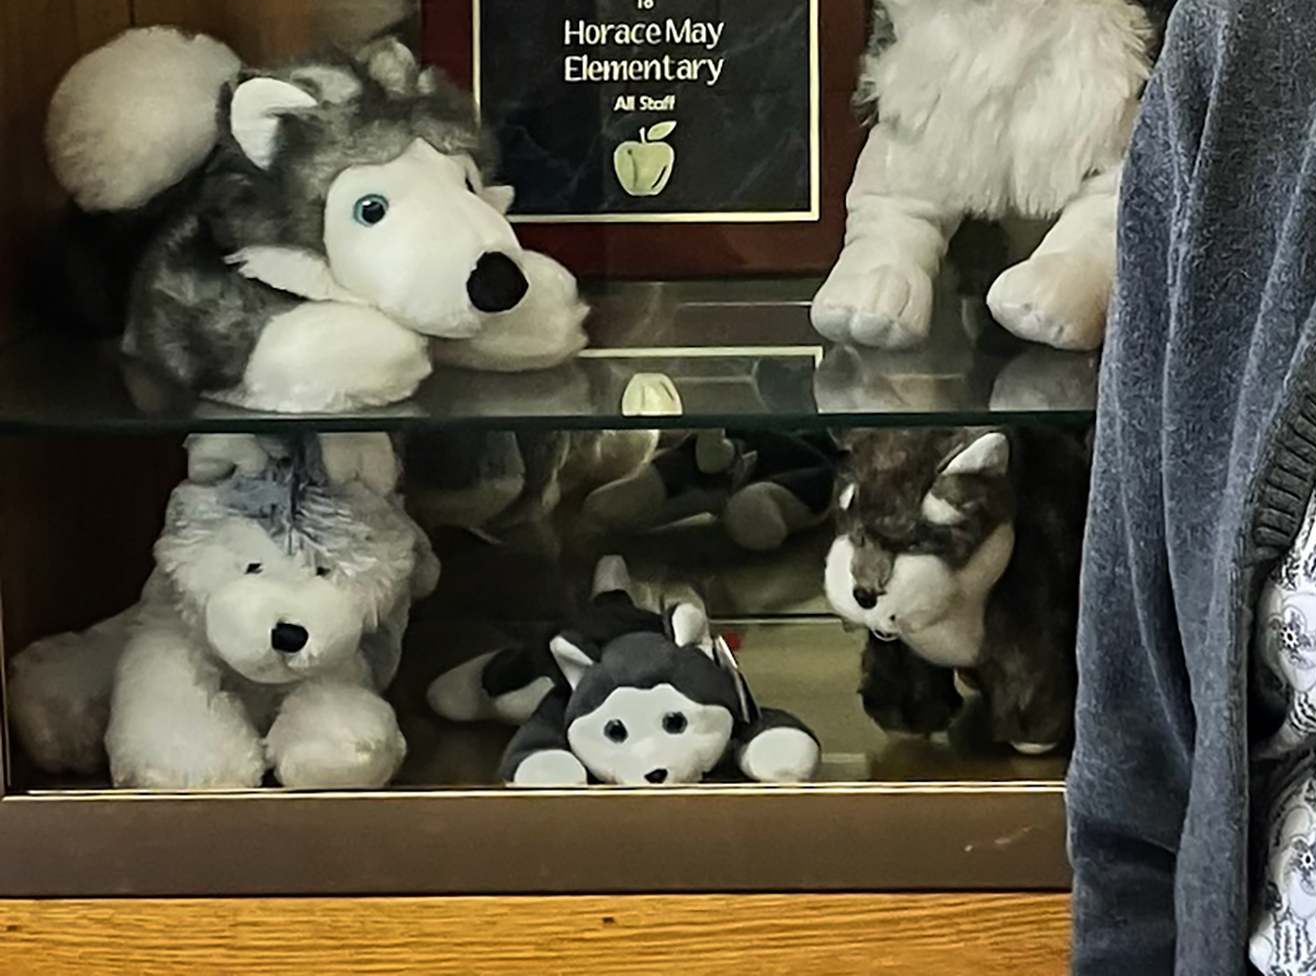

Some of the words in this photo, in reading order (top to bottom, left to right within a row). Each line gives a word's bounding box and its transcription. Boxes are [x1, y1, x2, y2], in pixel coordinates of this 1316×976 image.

[564, 19, 662, 45] Horace
[665, 18, 725, 49] May
[564, 54, 725, 86] Elementary
[614, 95, 635, 111] All
[639, 95, 676, 111] Staff
